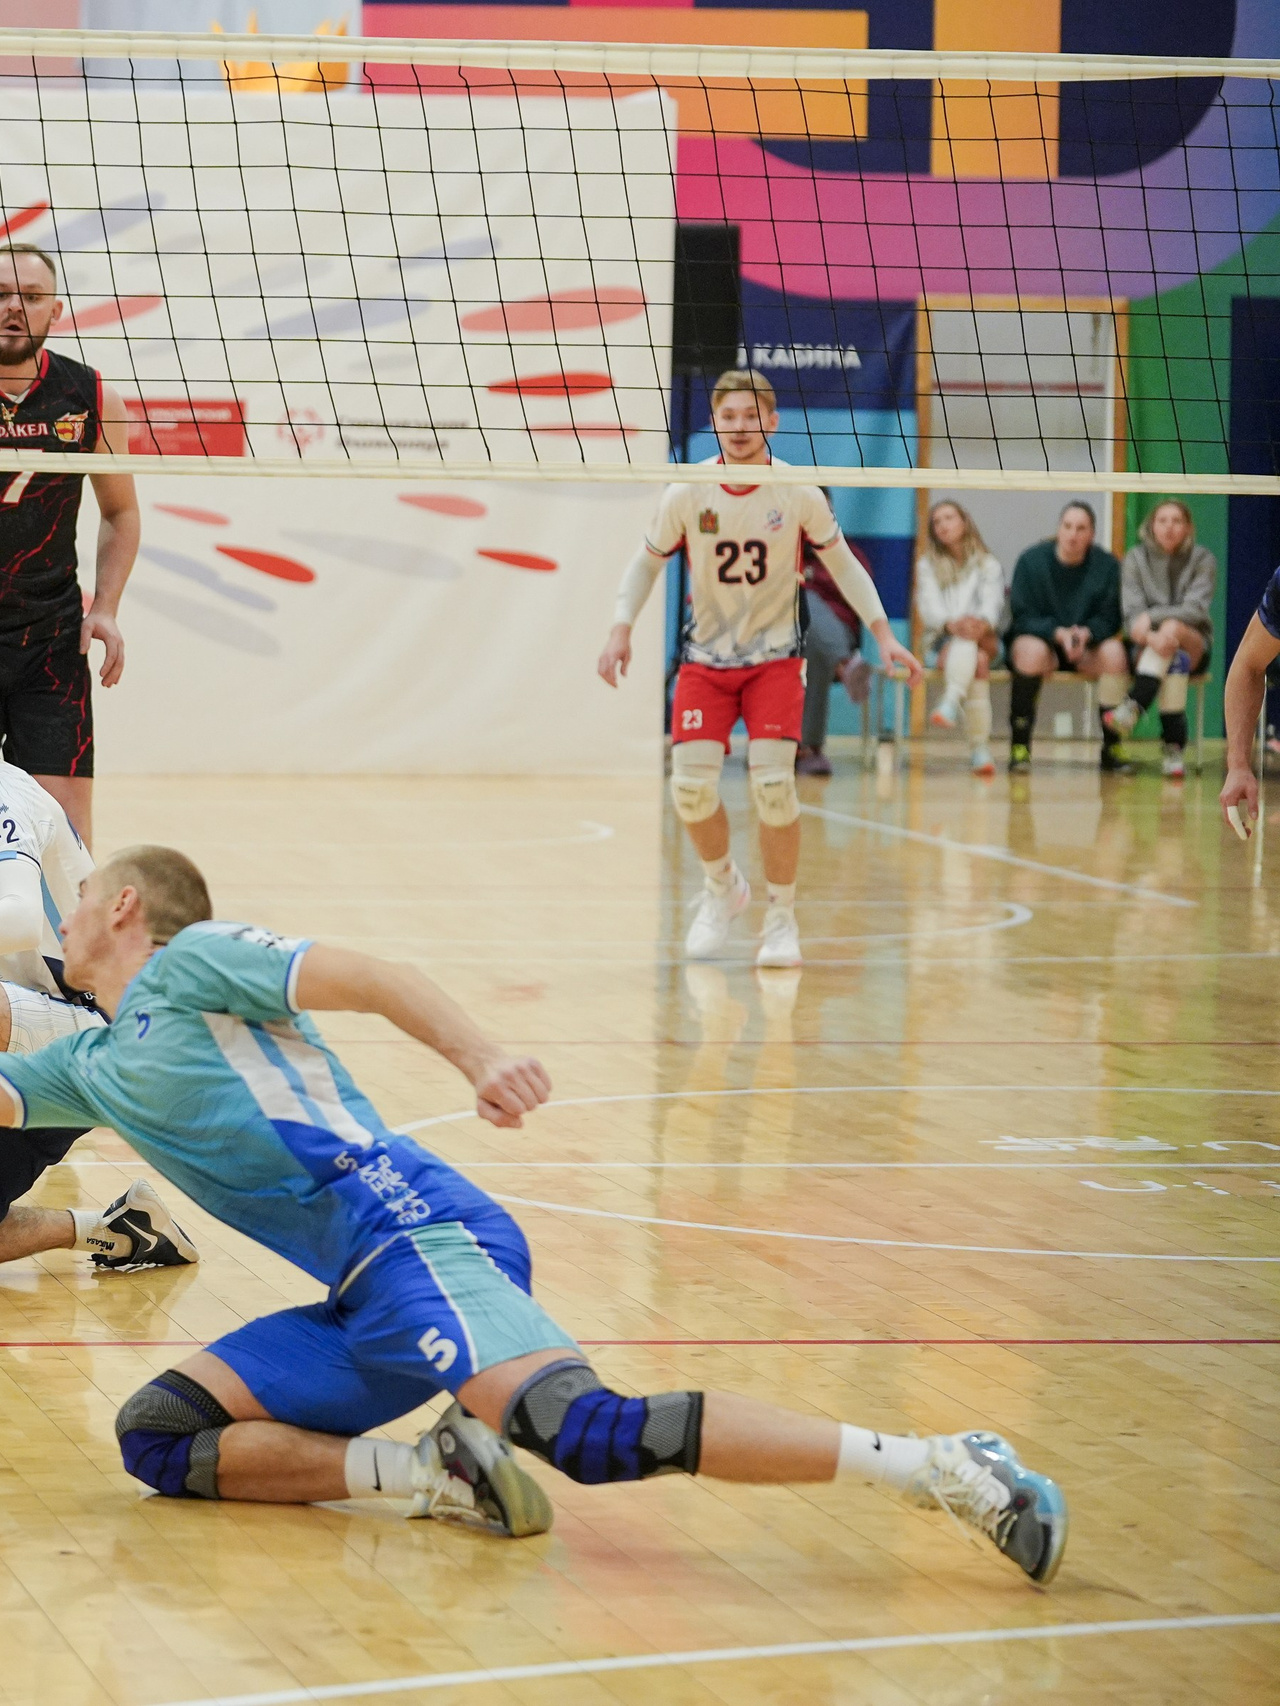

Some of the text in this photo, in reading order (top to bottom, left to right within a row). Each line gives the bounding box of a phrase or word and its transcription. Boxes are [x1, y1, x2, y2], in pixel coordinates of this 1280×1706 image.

[715, 540, 768, 586] 23
[682, 708, 703, 731] 23
[417, 1326, 458, 1373] 5
